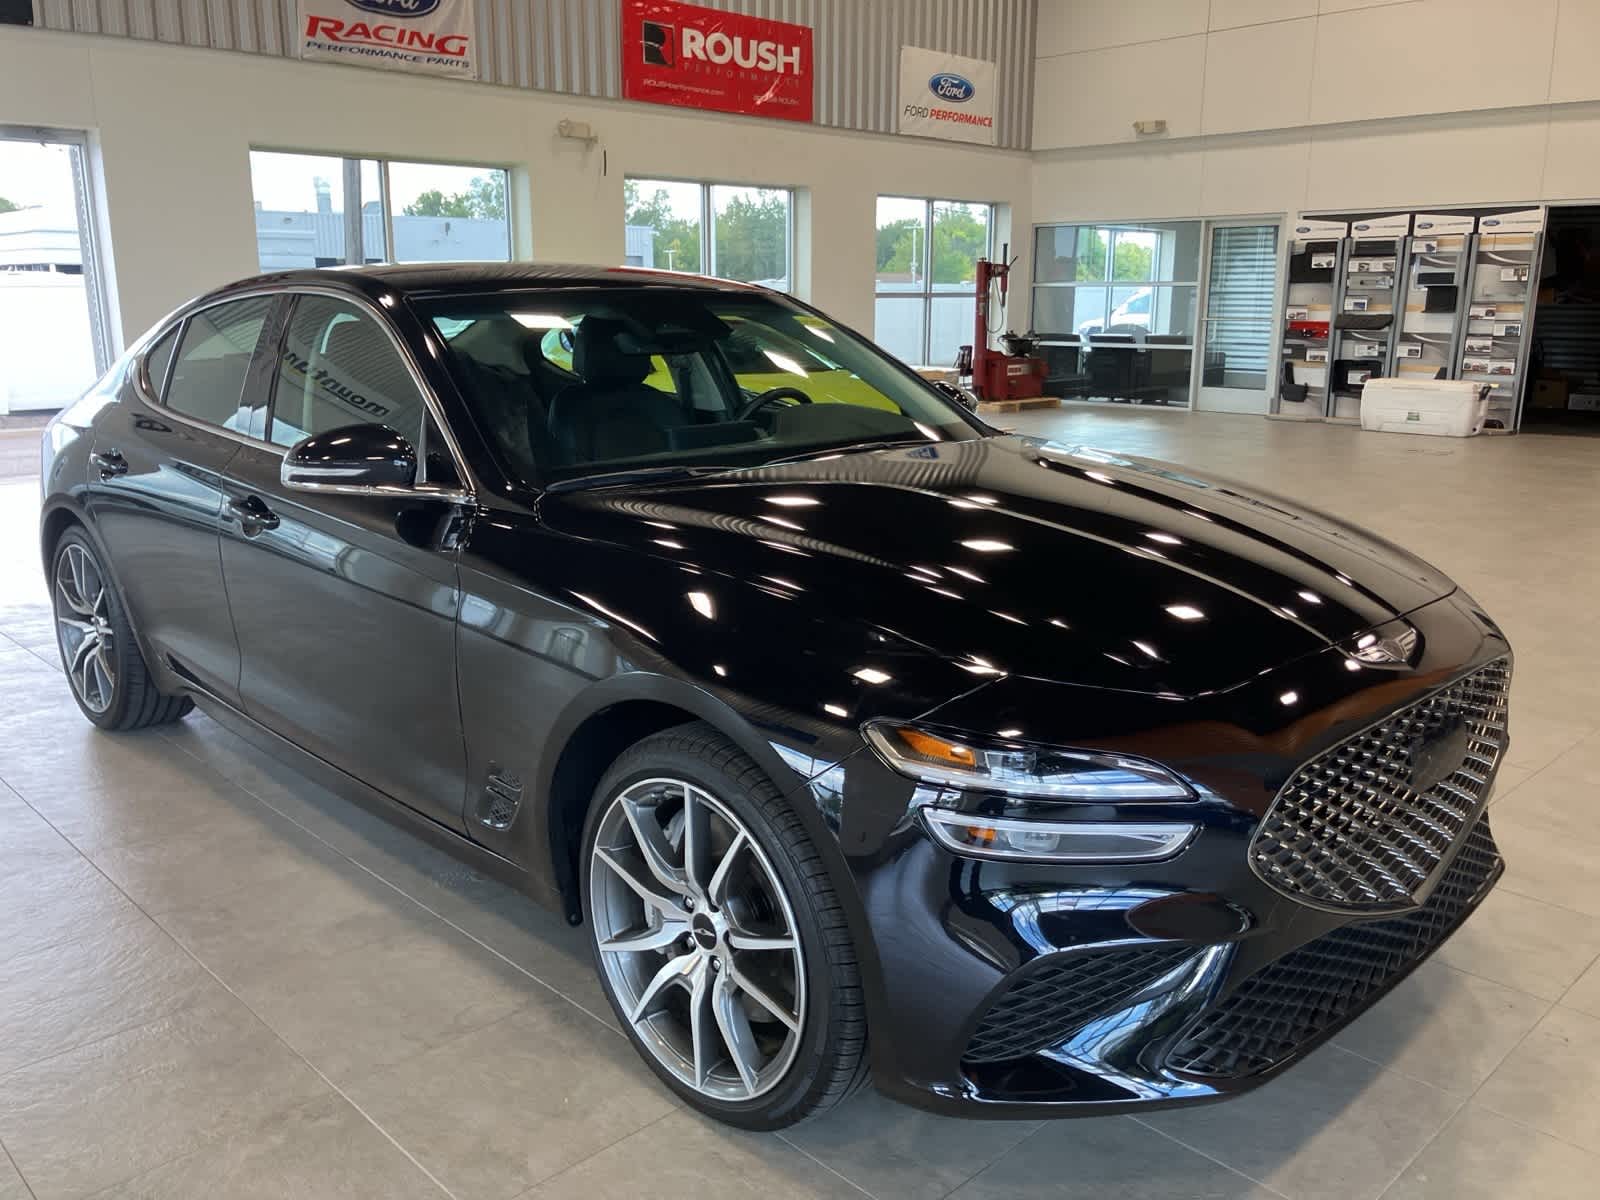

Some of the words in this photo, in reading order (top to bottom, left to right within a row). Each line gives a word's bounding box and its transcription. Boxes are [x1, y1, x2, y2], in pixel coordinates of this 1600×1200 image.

[306, 15, 469, 56] RACING
[306, 41, 424, 63] PERFORMANCE
[427, 56, 470, 68] PARTS
[682, 27, 801, 75] ROUSH
[937, 77, 966, 98] Ford
[903, 104, 929, 118] FORD
[929, 108, 993, 128] PERFORMANCE
